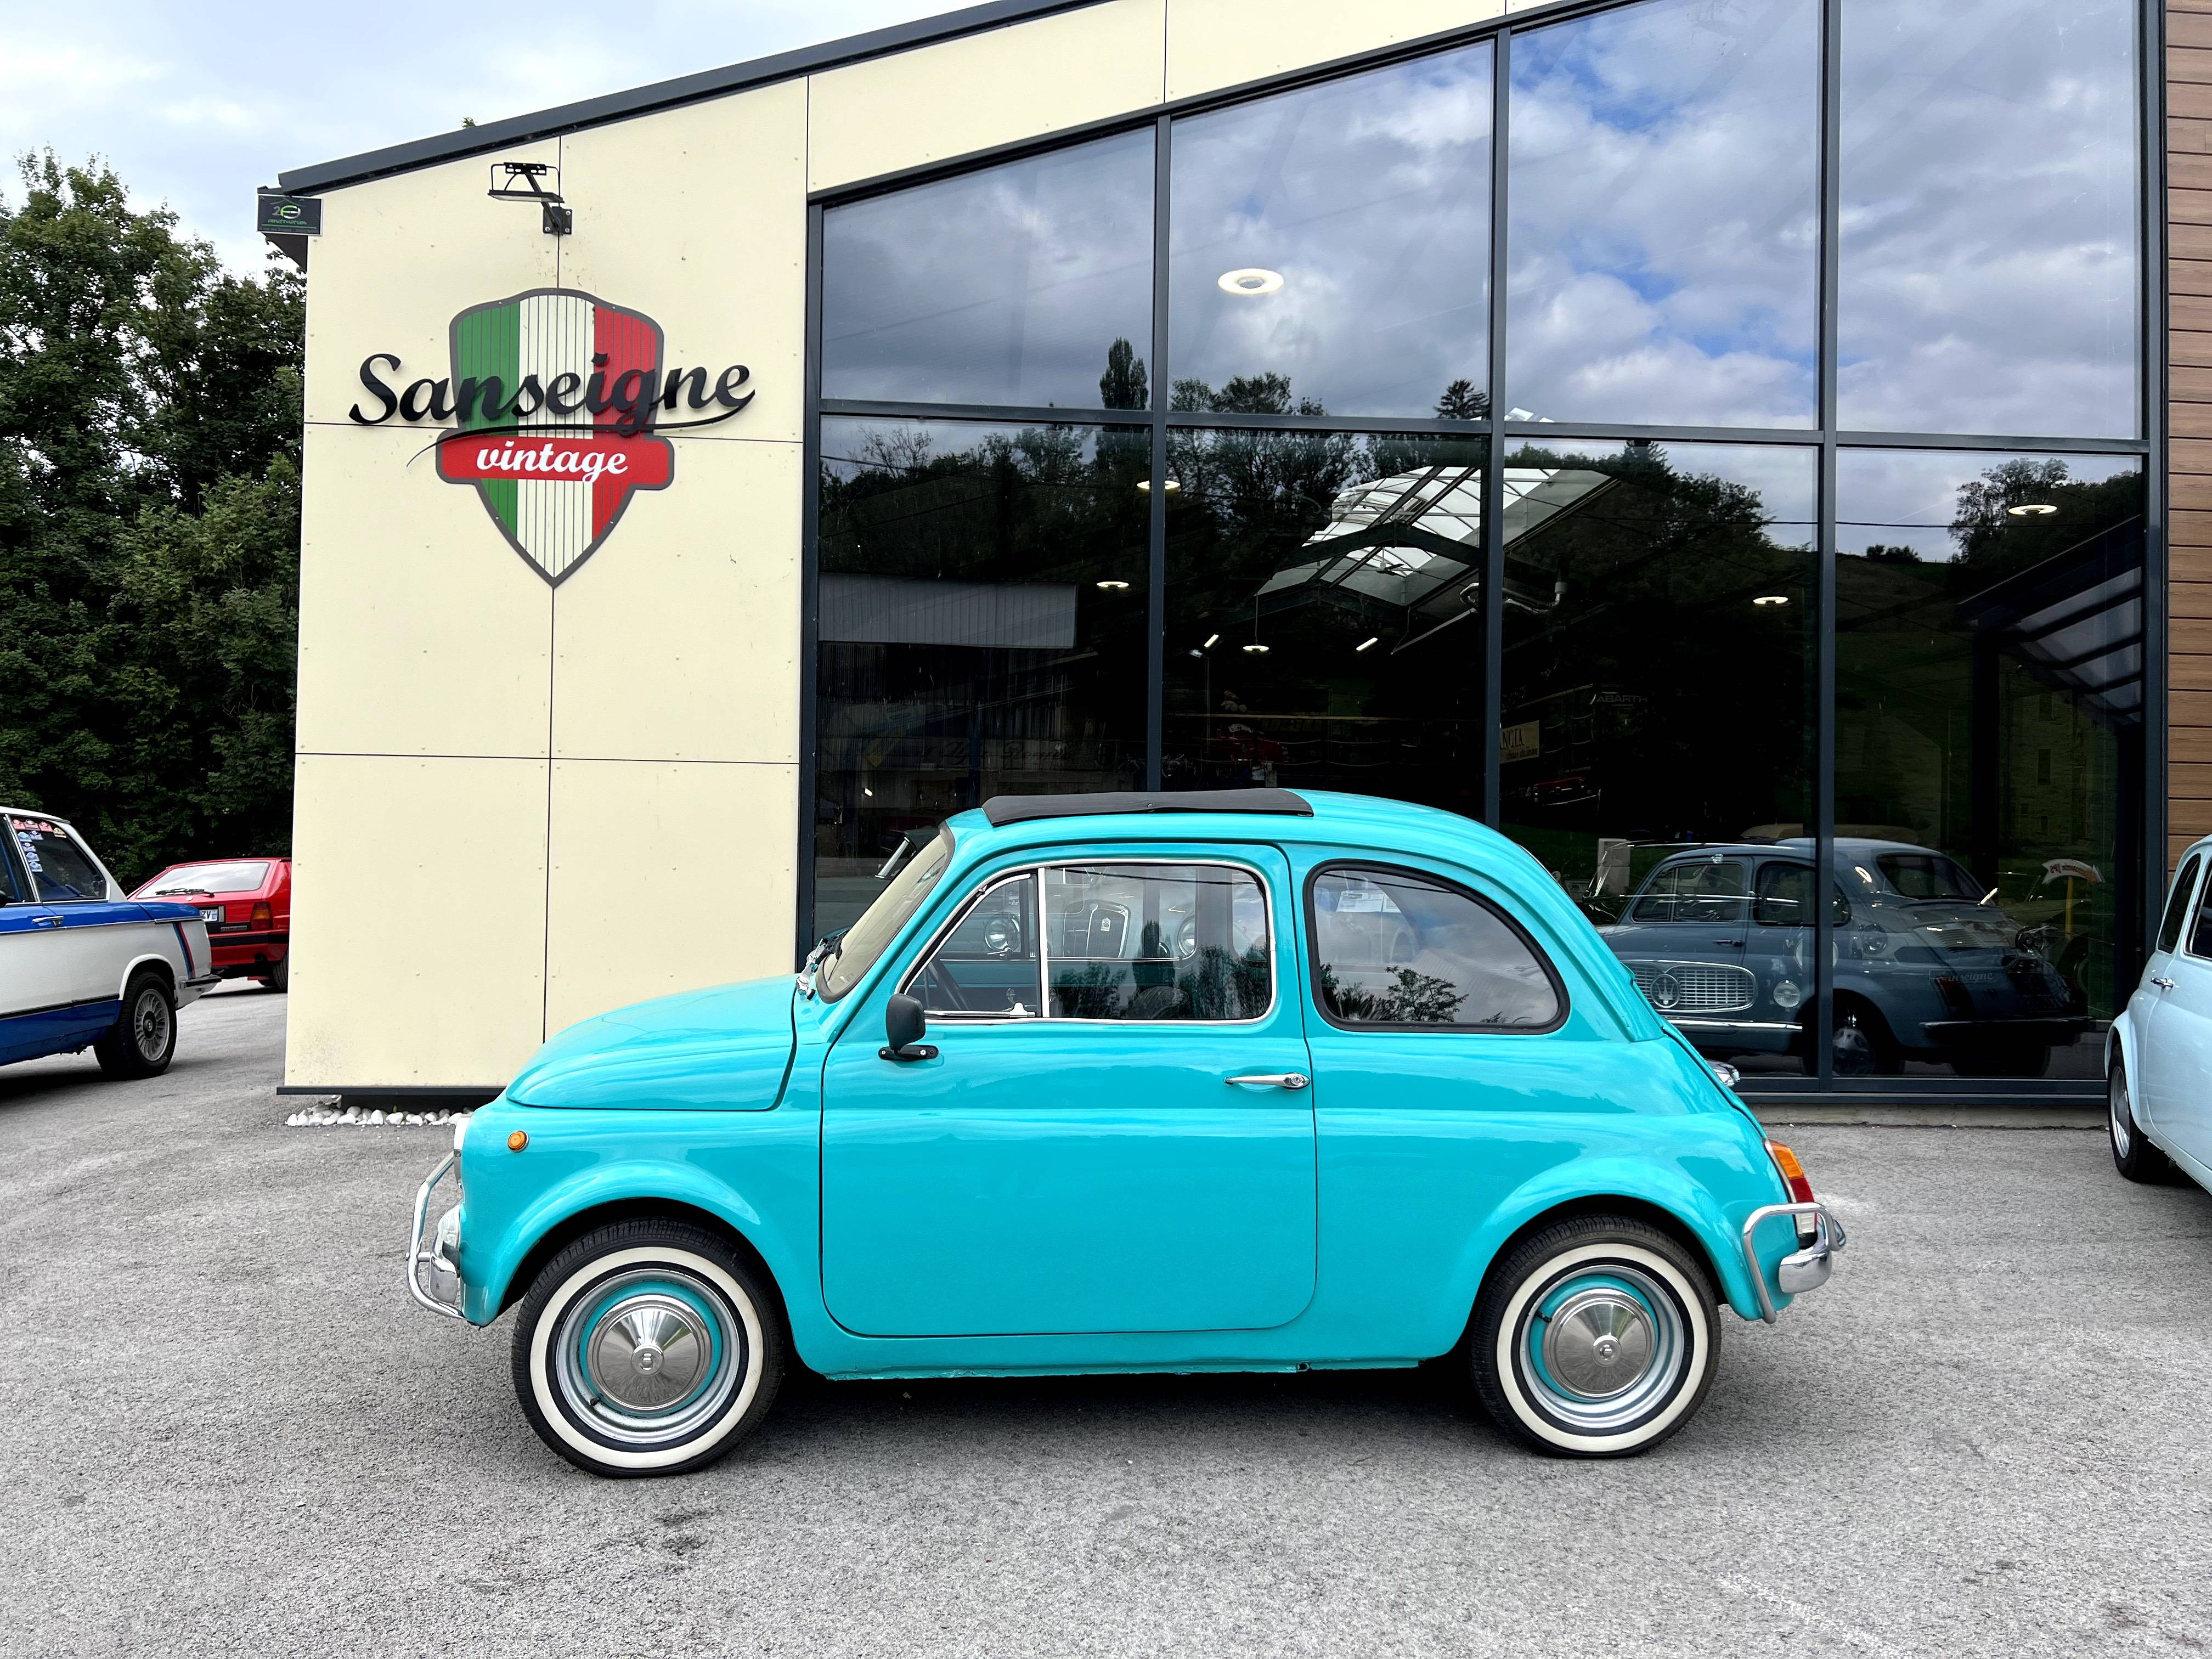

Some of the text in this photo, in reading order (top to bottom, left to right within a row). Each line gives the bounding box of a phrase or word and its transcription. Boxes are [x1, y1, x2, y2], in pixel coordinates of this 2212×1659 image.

[348, 353, 755, 436] Sanseigne
[476, 441, 628, 483] vintage
[1499, 727, 1525, 749] NCIA
